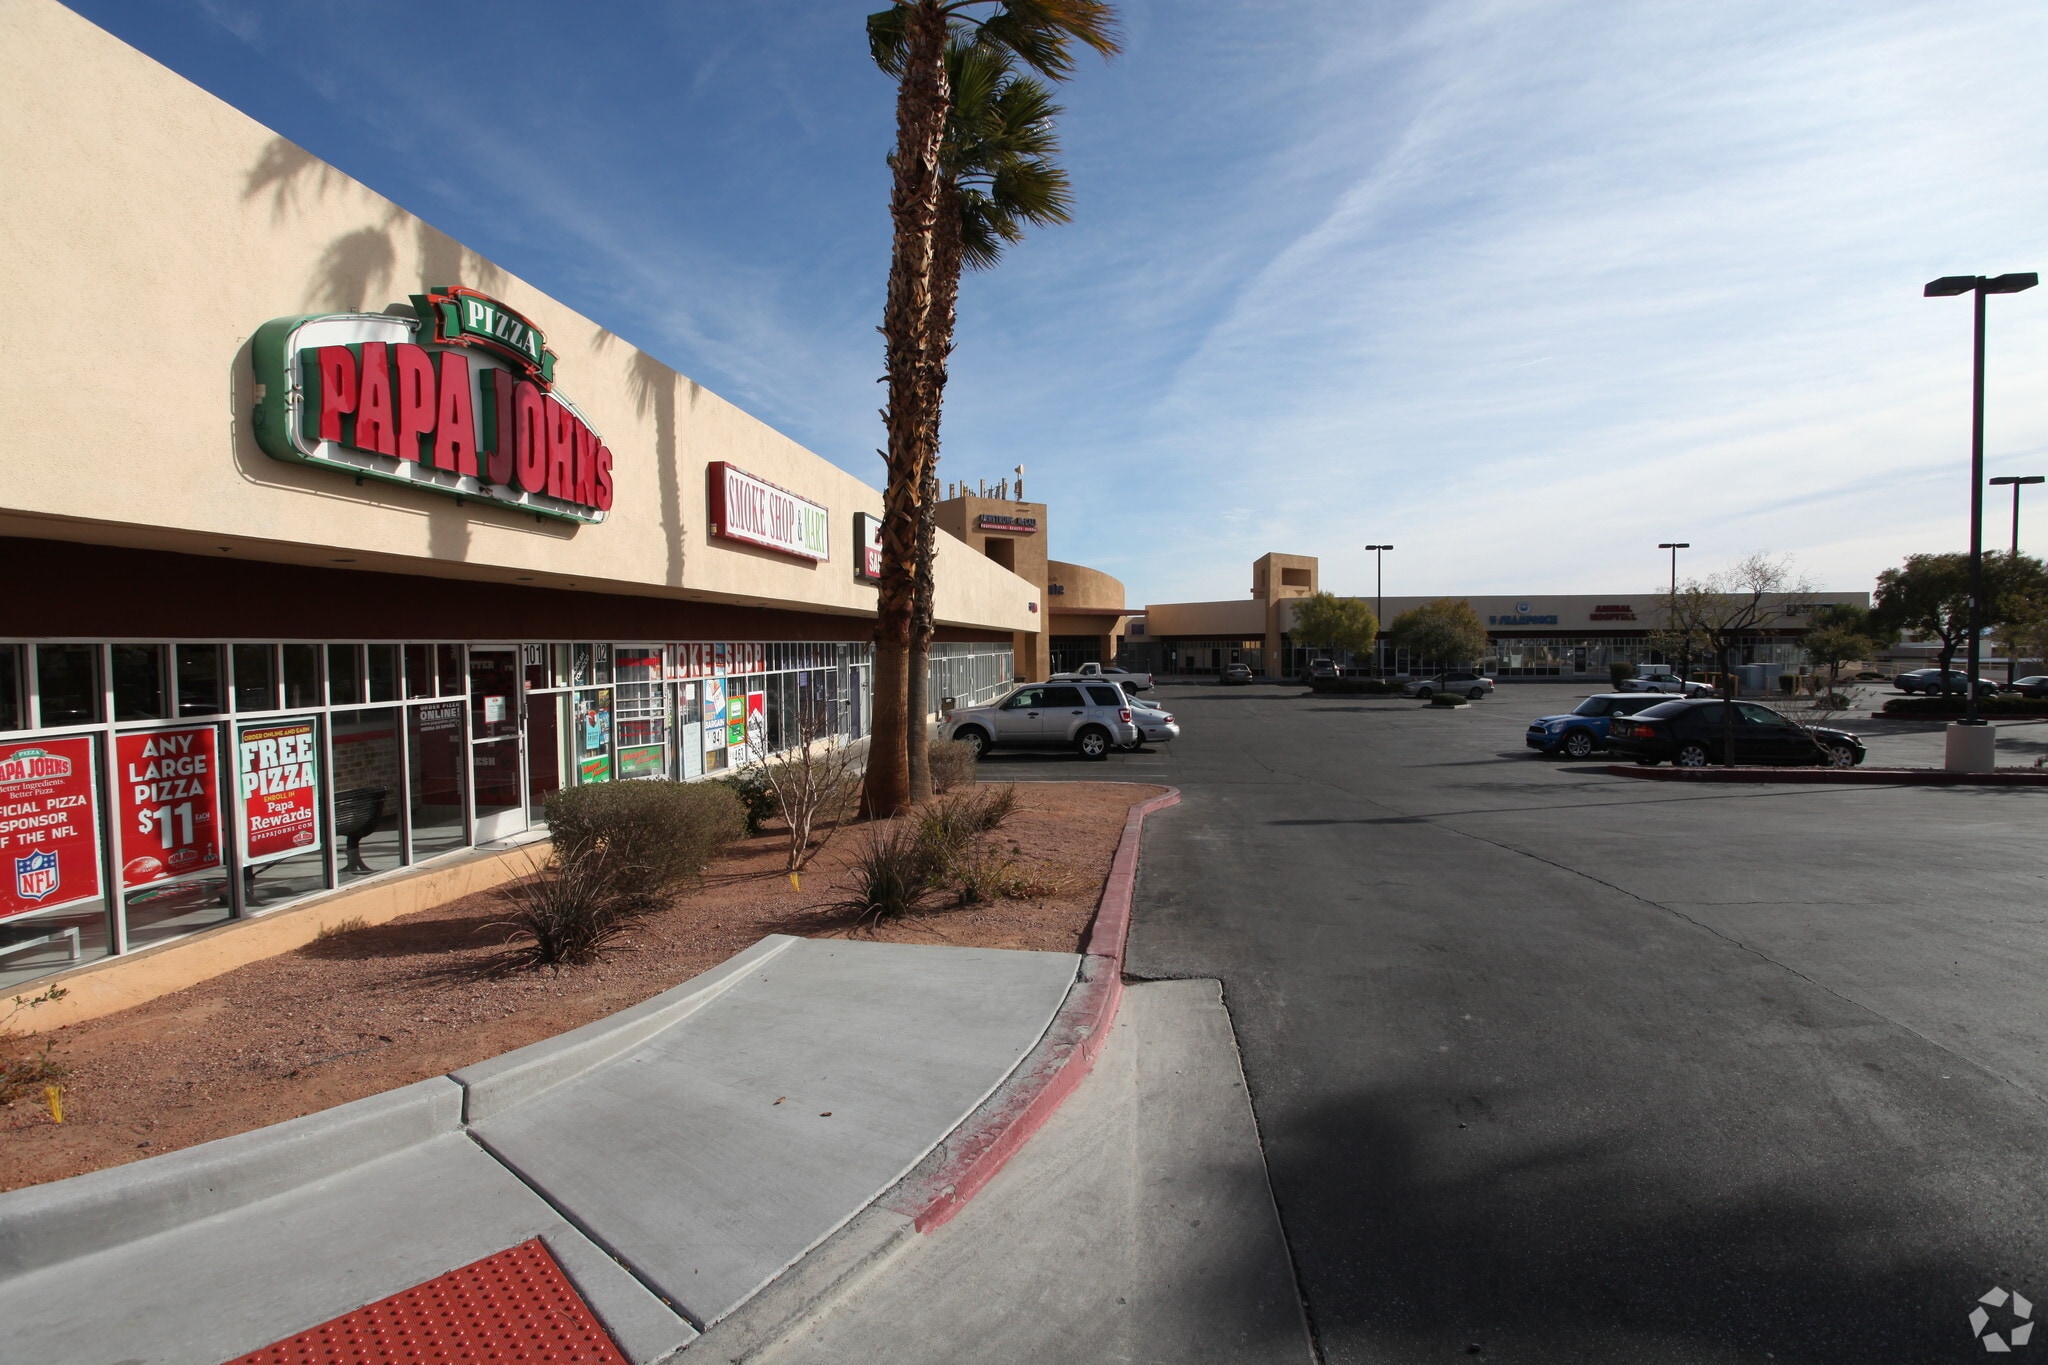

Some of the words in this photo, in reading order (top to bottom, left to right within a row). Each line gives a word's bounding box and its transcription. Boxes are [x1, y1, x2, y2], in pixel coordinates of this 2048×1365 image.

[467, 298, 537, 360] PIZZA
[319, 341, 478, 477] PAPA
[728, 475, 766, 537] SMOKE
[769, 492, 794, 545] SHOP
[797, 509, 803, 542] &
[804, 506, 825, 554] MART
[524, 645, 542, 665] 101
[727, 644, 761, 674] SHOP
[420, 707, 460, 721] ONLINE!
[142, 734, 194, 758] ANY
[244, 733, 263, 742] ORDER
[263, 730, 283, 738] ONLINE
[240, 733, 313, 774] FREE
[0, 760, 25, 781] APA
[129, 754, 207, 782] LARGE
[9, 790, 33, 799] Better
[35, 787, 55, 796] Pizza.
[22, 778, 65, 791] Ingredients.
[135, 777, 204, 805] PIZZA
[242, 762, 315, 800] PIZZA
[47, 795, 87, 810] PIZZA
[264, 793, 287, 803] ENROLL
[267, 800, 294, 814] Papa
[0, 812, 67, 833] SPONSOR
[138, 801, 194, 849] $11
[195, 812, 210, 821] EACH
[250, 807, 312, 831] Rewards
[0, 837, 9, 848] F
[17, 830, 45, 846] THE
[52, 826, 78, 839] NFL
[22, 869, 55, 893] NFL
